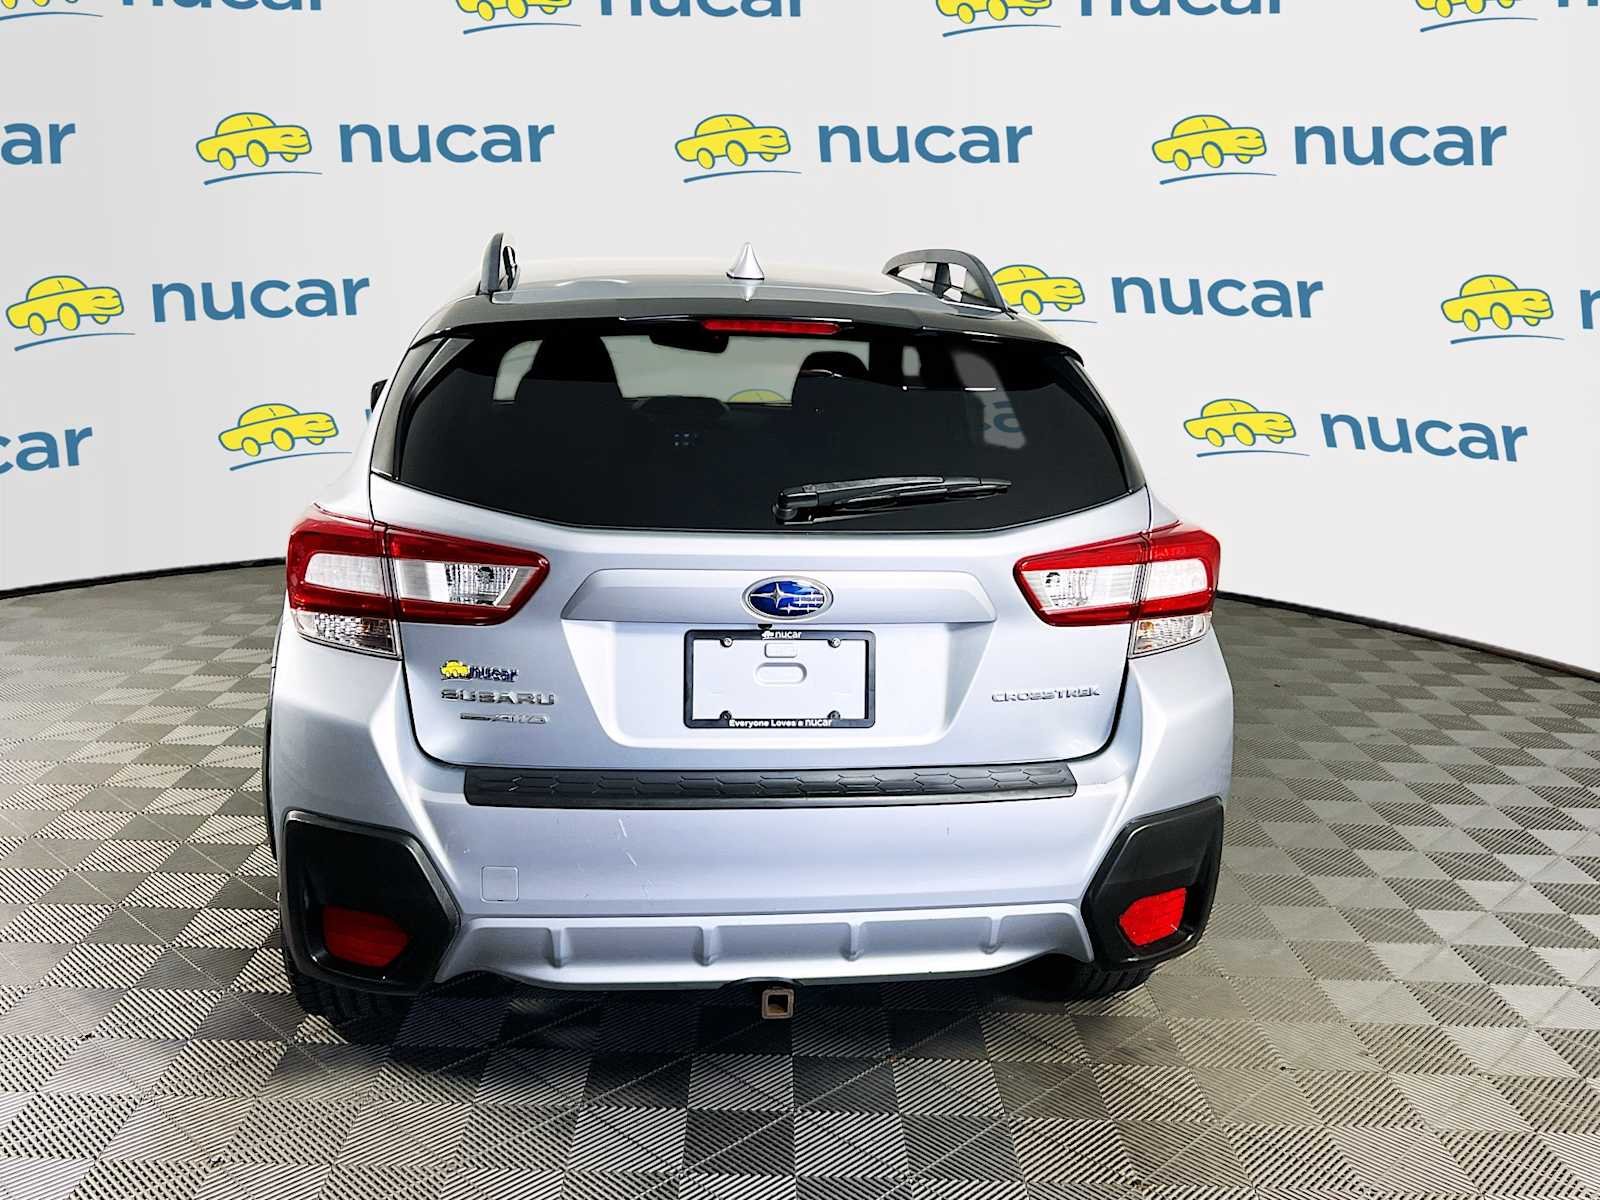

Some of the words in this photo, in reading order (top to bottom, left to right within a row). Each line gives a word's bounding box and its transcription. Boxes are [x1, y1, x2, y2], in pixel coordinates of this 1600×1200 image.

[339, 123, 555, 163] nucar
[818, 125, 1033, 164] nucar
[1294, 125, 1507, 166] nucar
[152, 277, 369, 323] nucar
[1111, 276, 1324, 318] nucar
[1321, 413, 1528, 462] nucar
[774, 631, 803, 639] nucar
[469, 665, 519, 682] nucar
[441, 689, 555, 706] SUBARU
[992, 687, 1101, 702] CROSSTREK
[728, 719, 769, 728] Everyone
[771, 719, 796, 727] Loves
[805, 719, 832, 727] nucar
